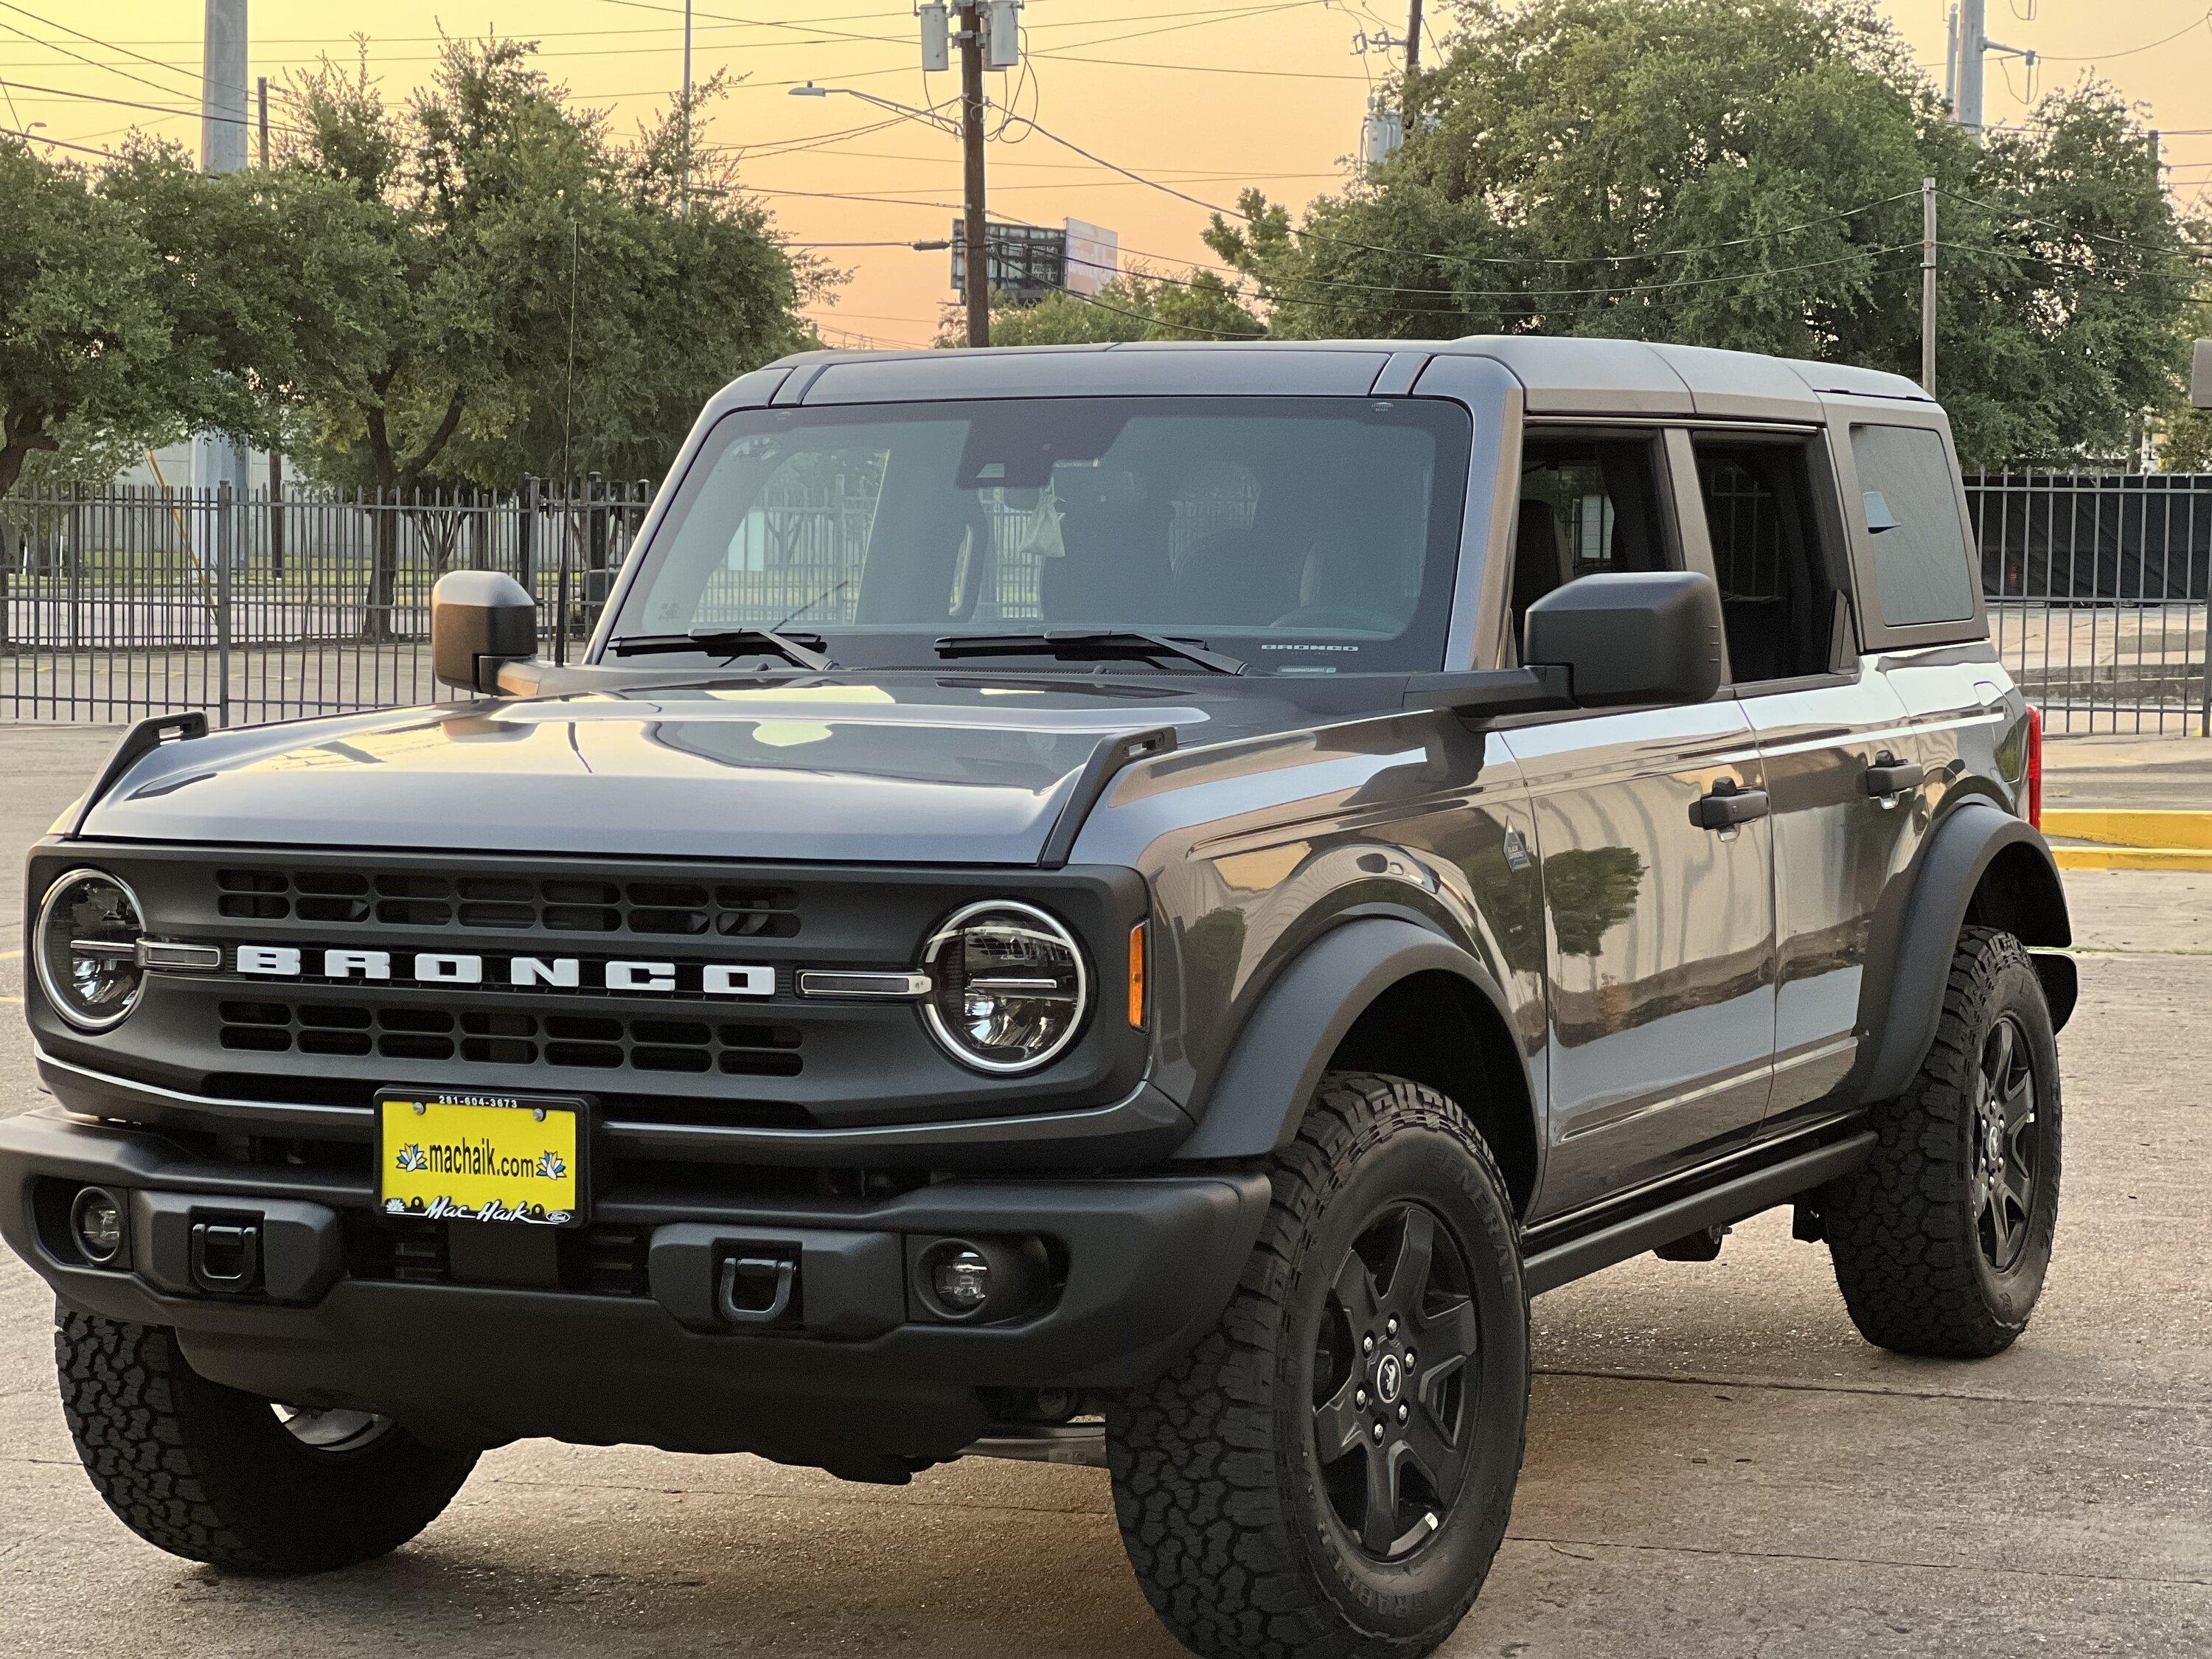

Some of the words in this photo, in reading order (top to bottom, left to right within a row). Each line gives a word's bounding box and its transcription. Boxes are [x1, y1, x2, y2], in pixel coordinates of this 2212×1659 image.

[237, 945, 775, 995] BRONCO
[439, 1096, 517, 1108] 281-604-3673
[429, 1137, 534, 1178] machaik.com
[424, 1195, 476, 1220] Mac
[476, 1198, 529, 1222] Haik
